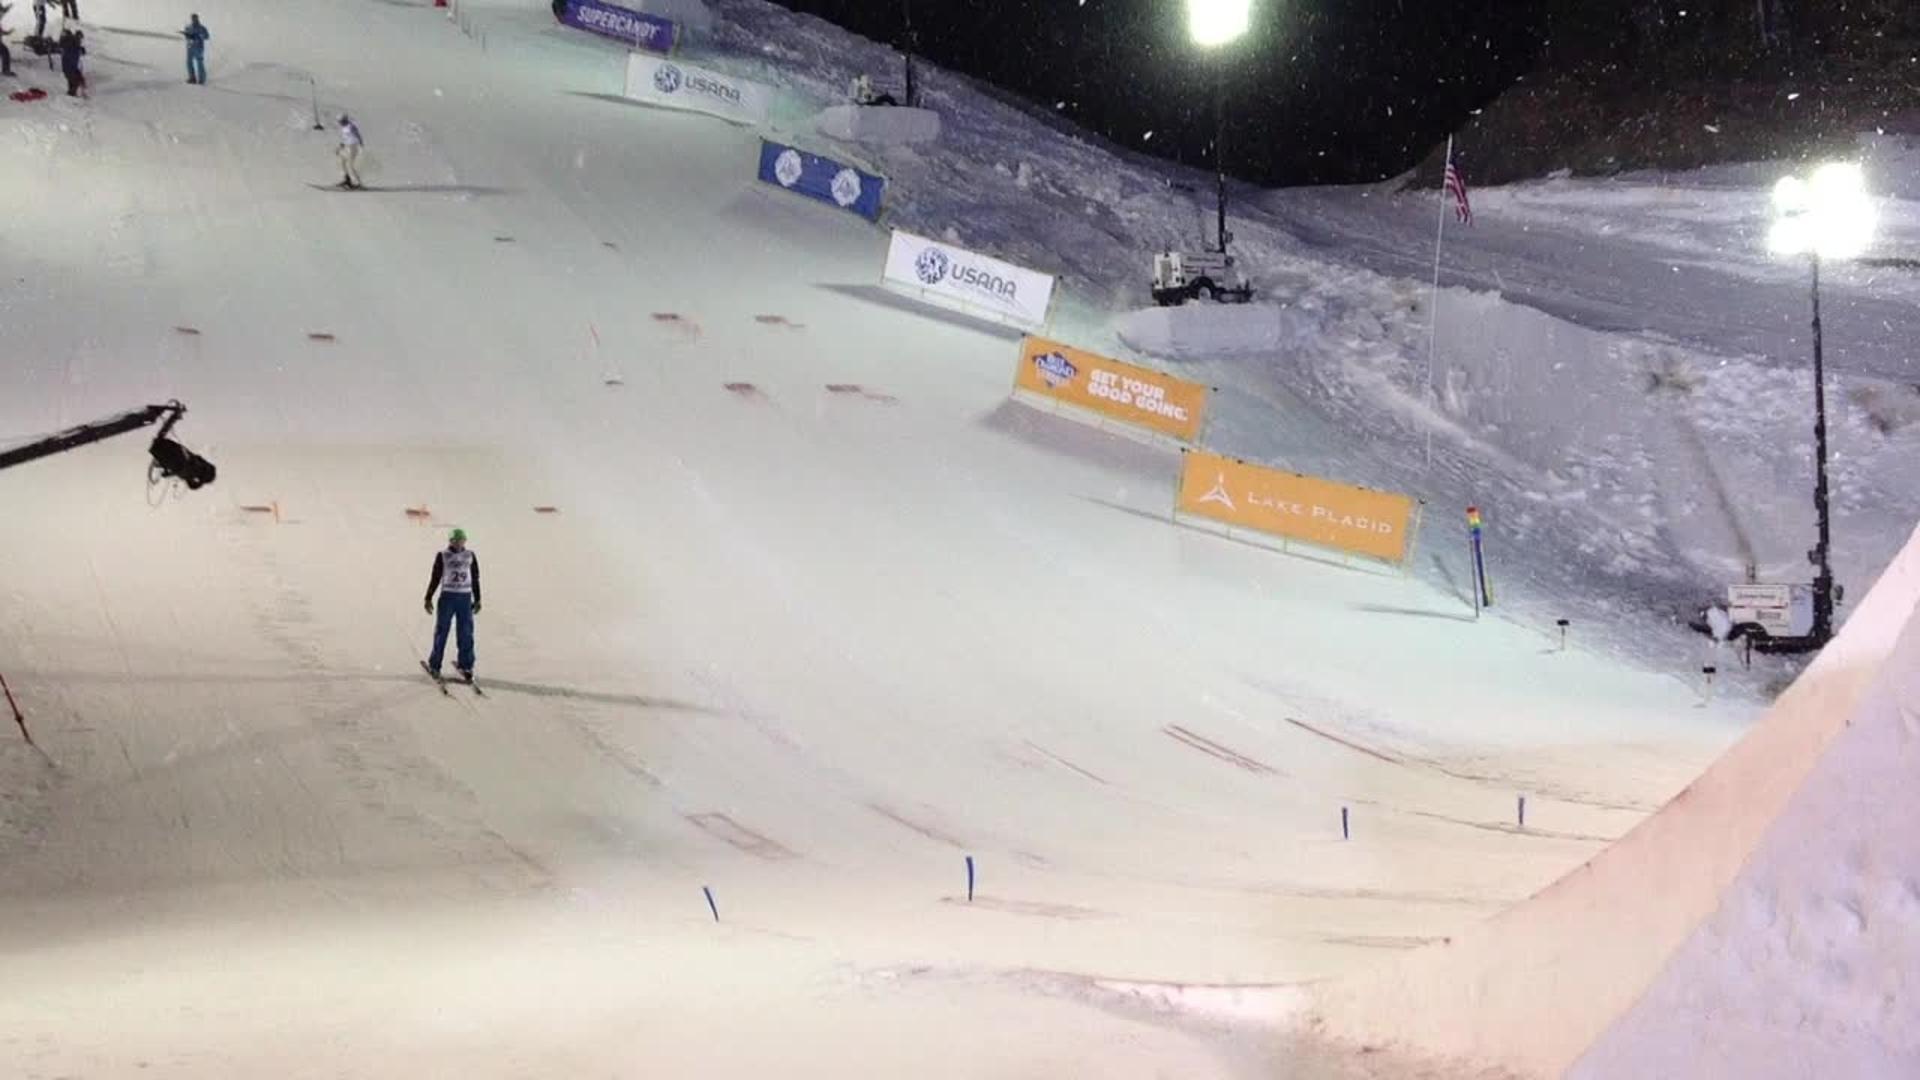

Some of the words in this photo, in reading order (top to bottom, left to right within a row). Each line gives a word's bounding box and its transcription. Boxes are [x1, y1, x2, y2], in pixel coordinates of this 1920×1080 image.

[577, 5, 658, 39] SUPERCANDY
[685, 74, 741, 101] USANA
[951, 263, 1017, 299] USANA
[1088, 381, 1132, 403] GOOD
[1091, 369, 1118, 387] GET
[1121, 376, 1165, 400] YOUR
[1248, 492, 1303, 515] LAKE
[1312, 506, 1393, 534] PLACID
[451, 571, 467, 582] 29
